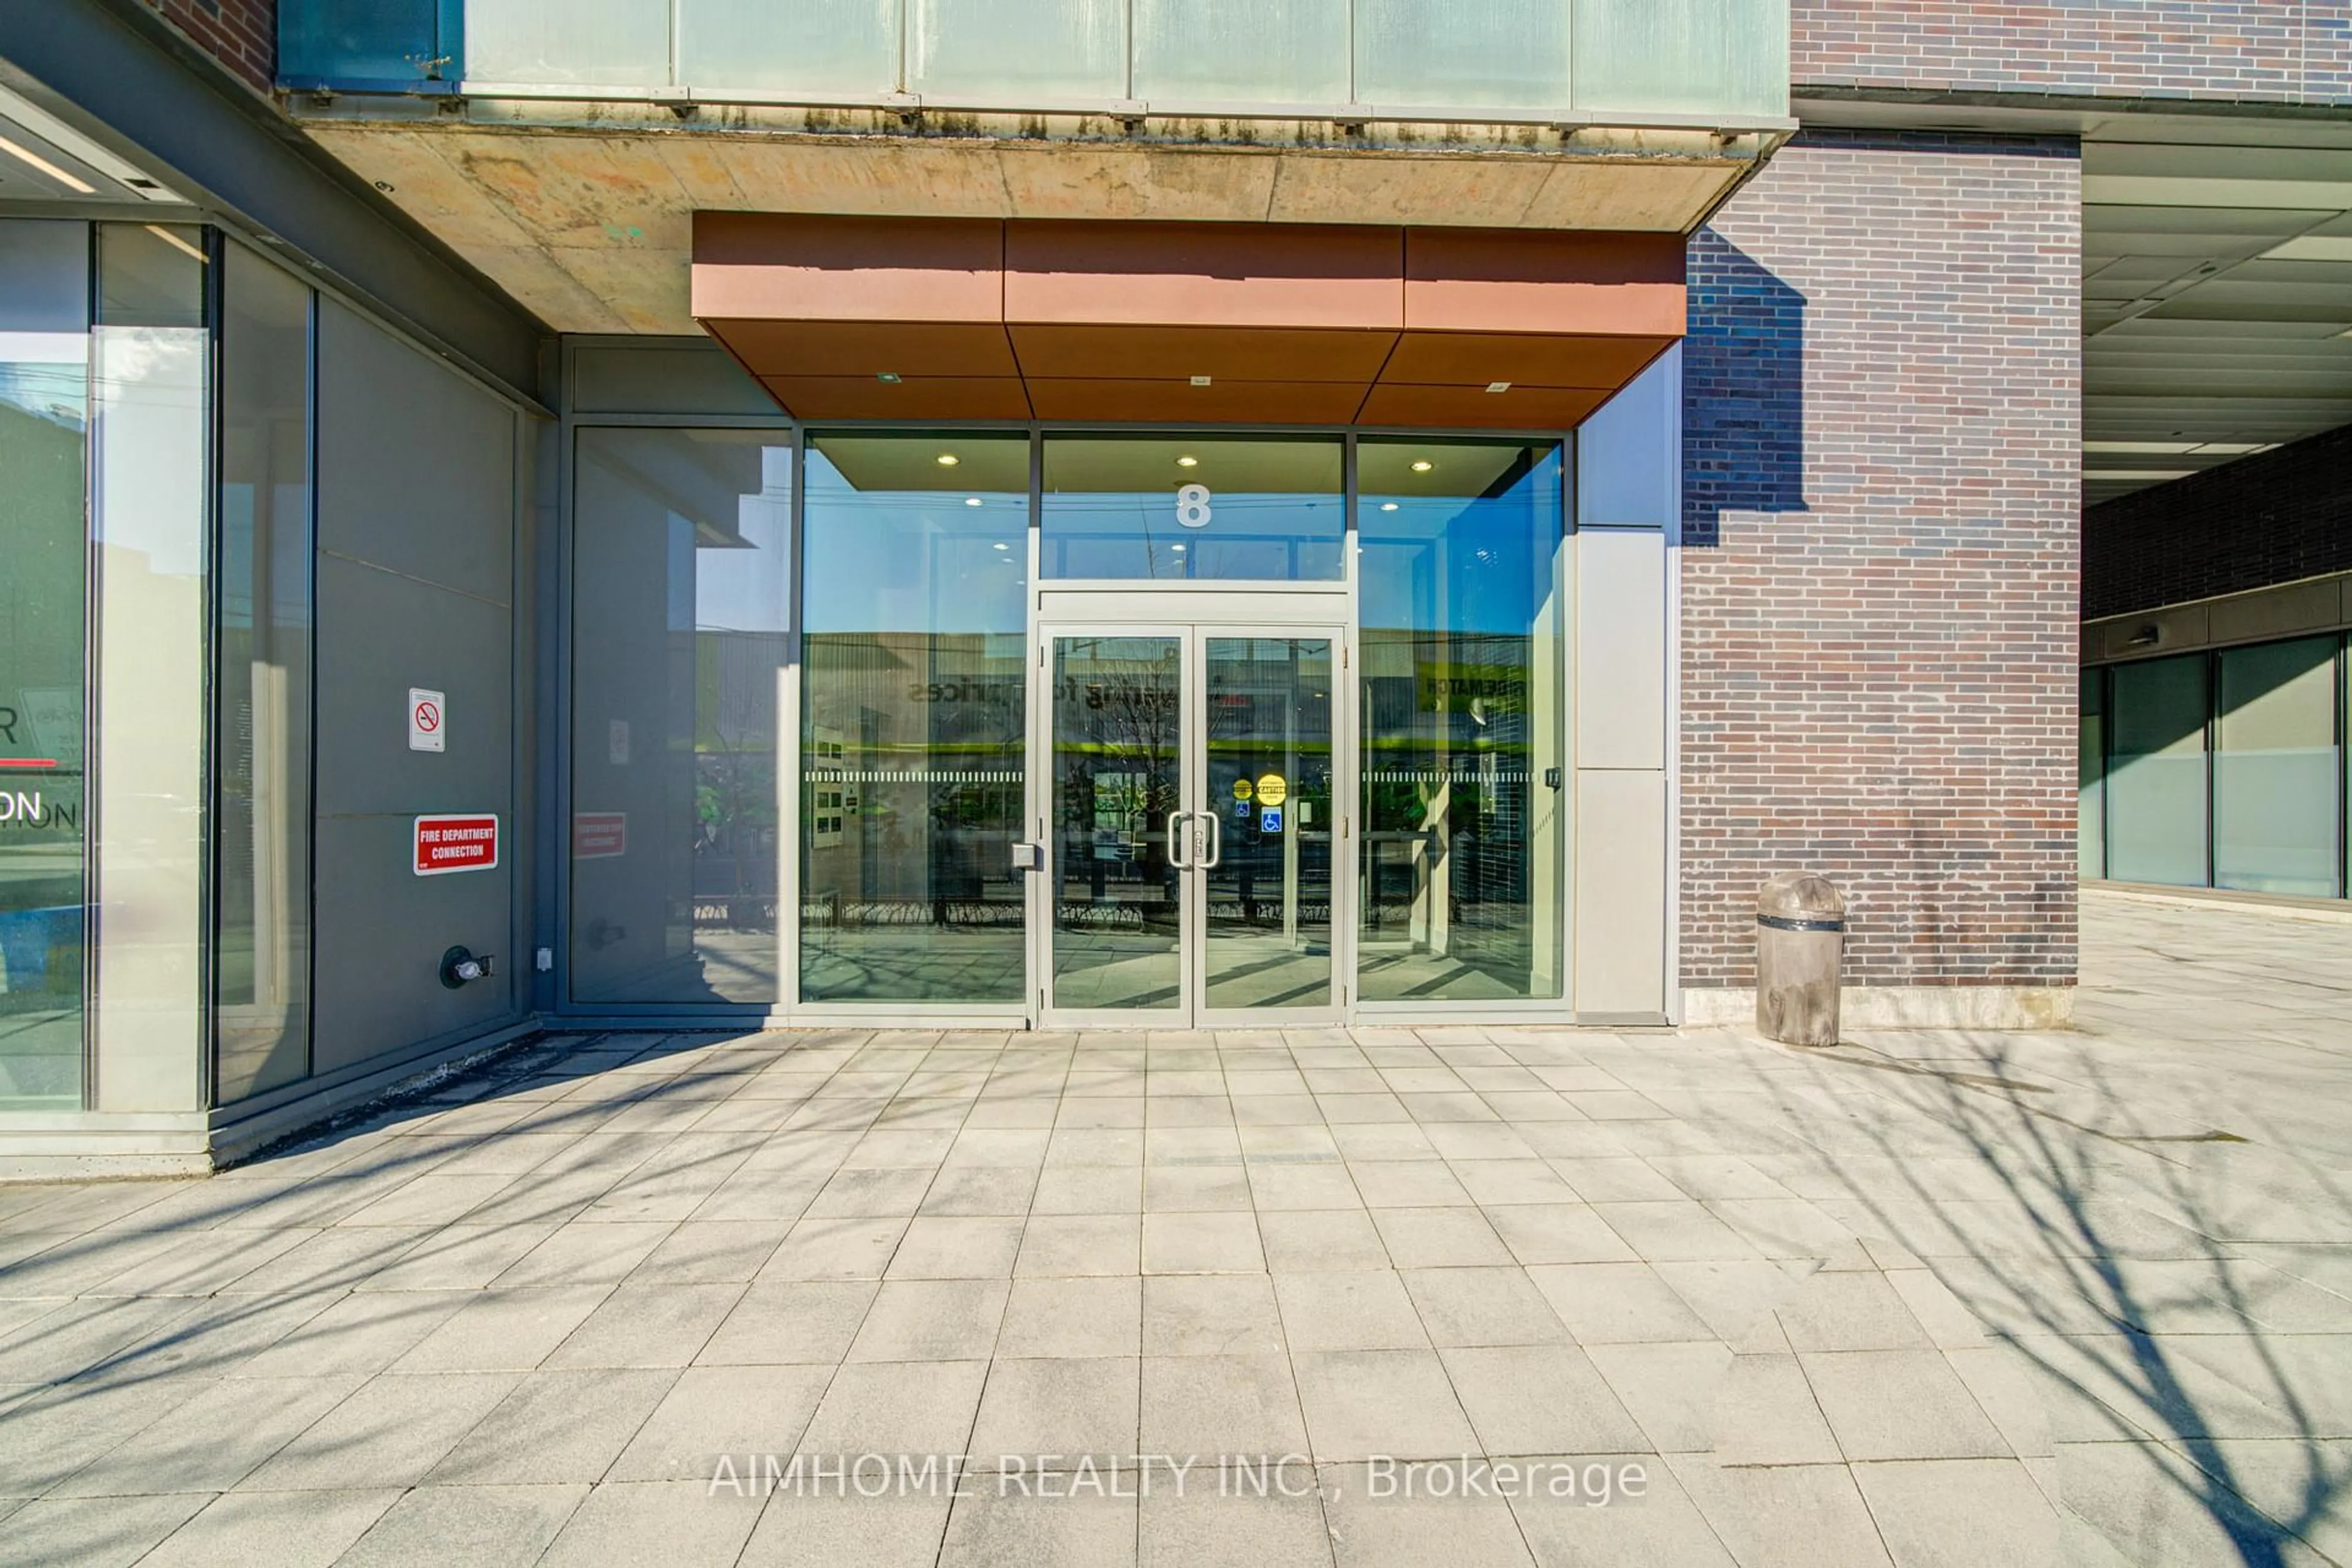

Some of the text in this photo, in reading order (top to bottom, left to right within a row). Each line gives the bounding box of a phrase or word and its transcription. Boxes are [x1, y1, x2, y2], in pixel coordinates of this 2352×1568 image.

[1176, 484, 1212, 527] 8
[420, 827, 494, 843] FIRE DEPARTMENT
[432, 845, 484, 860] CONNECTION
